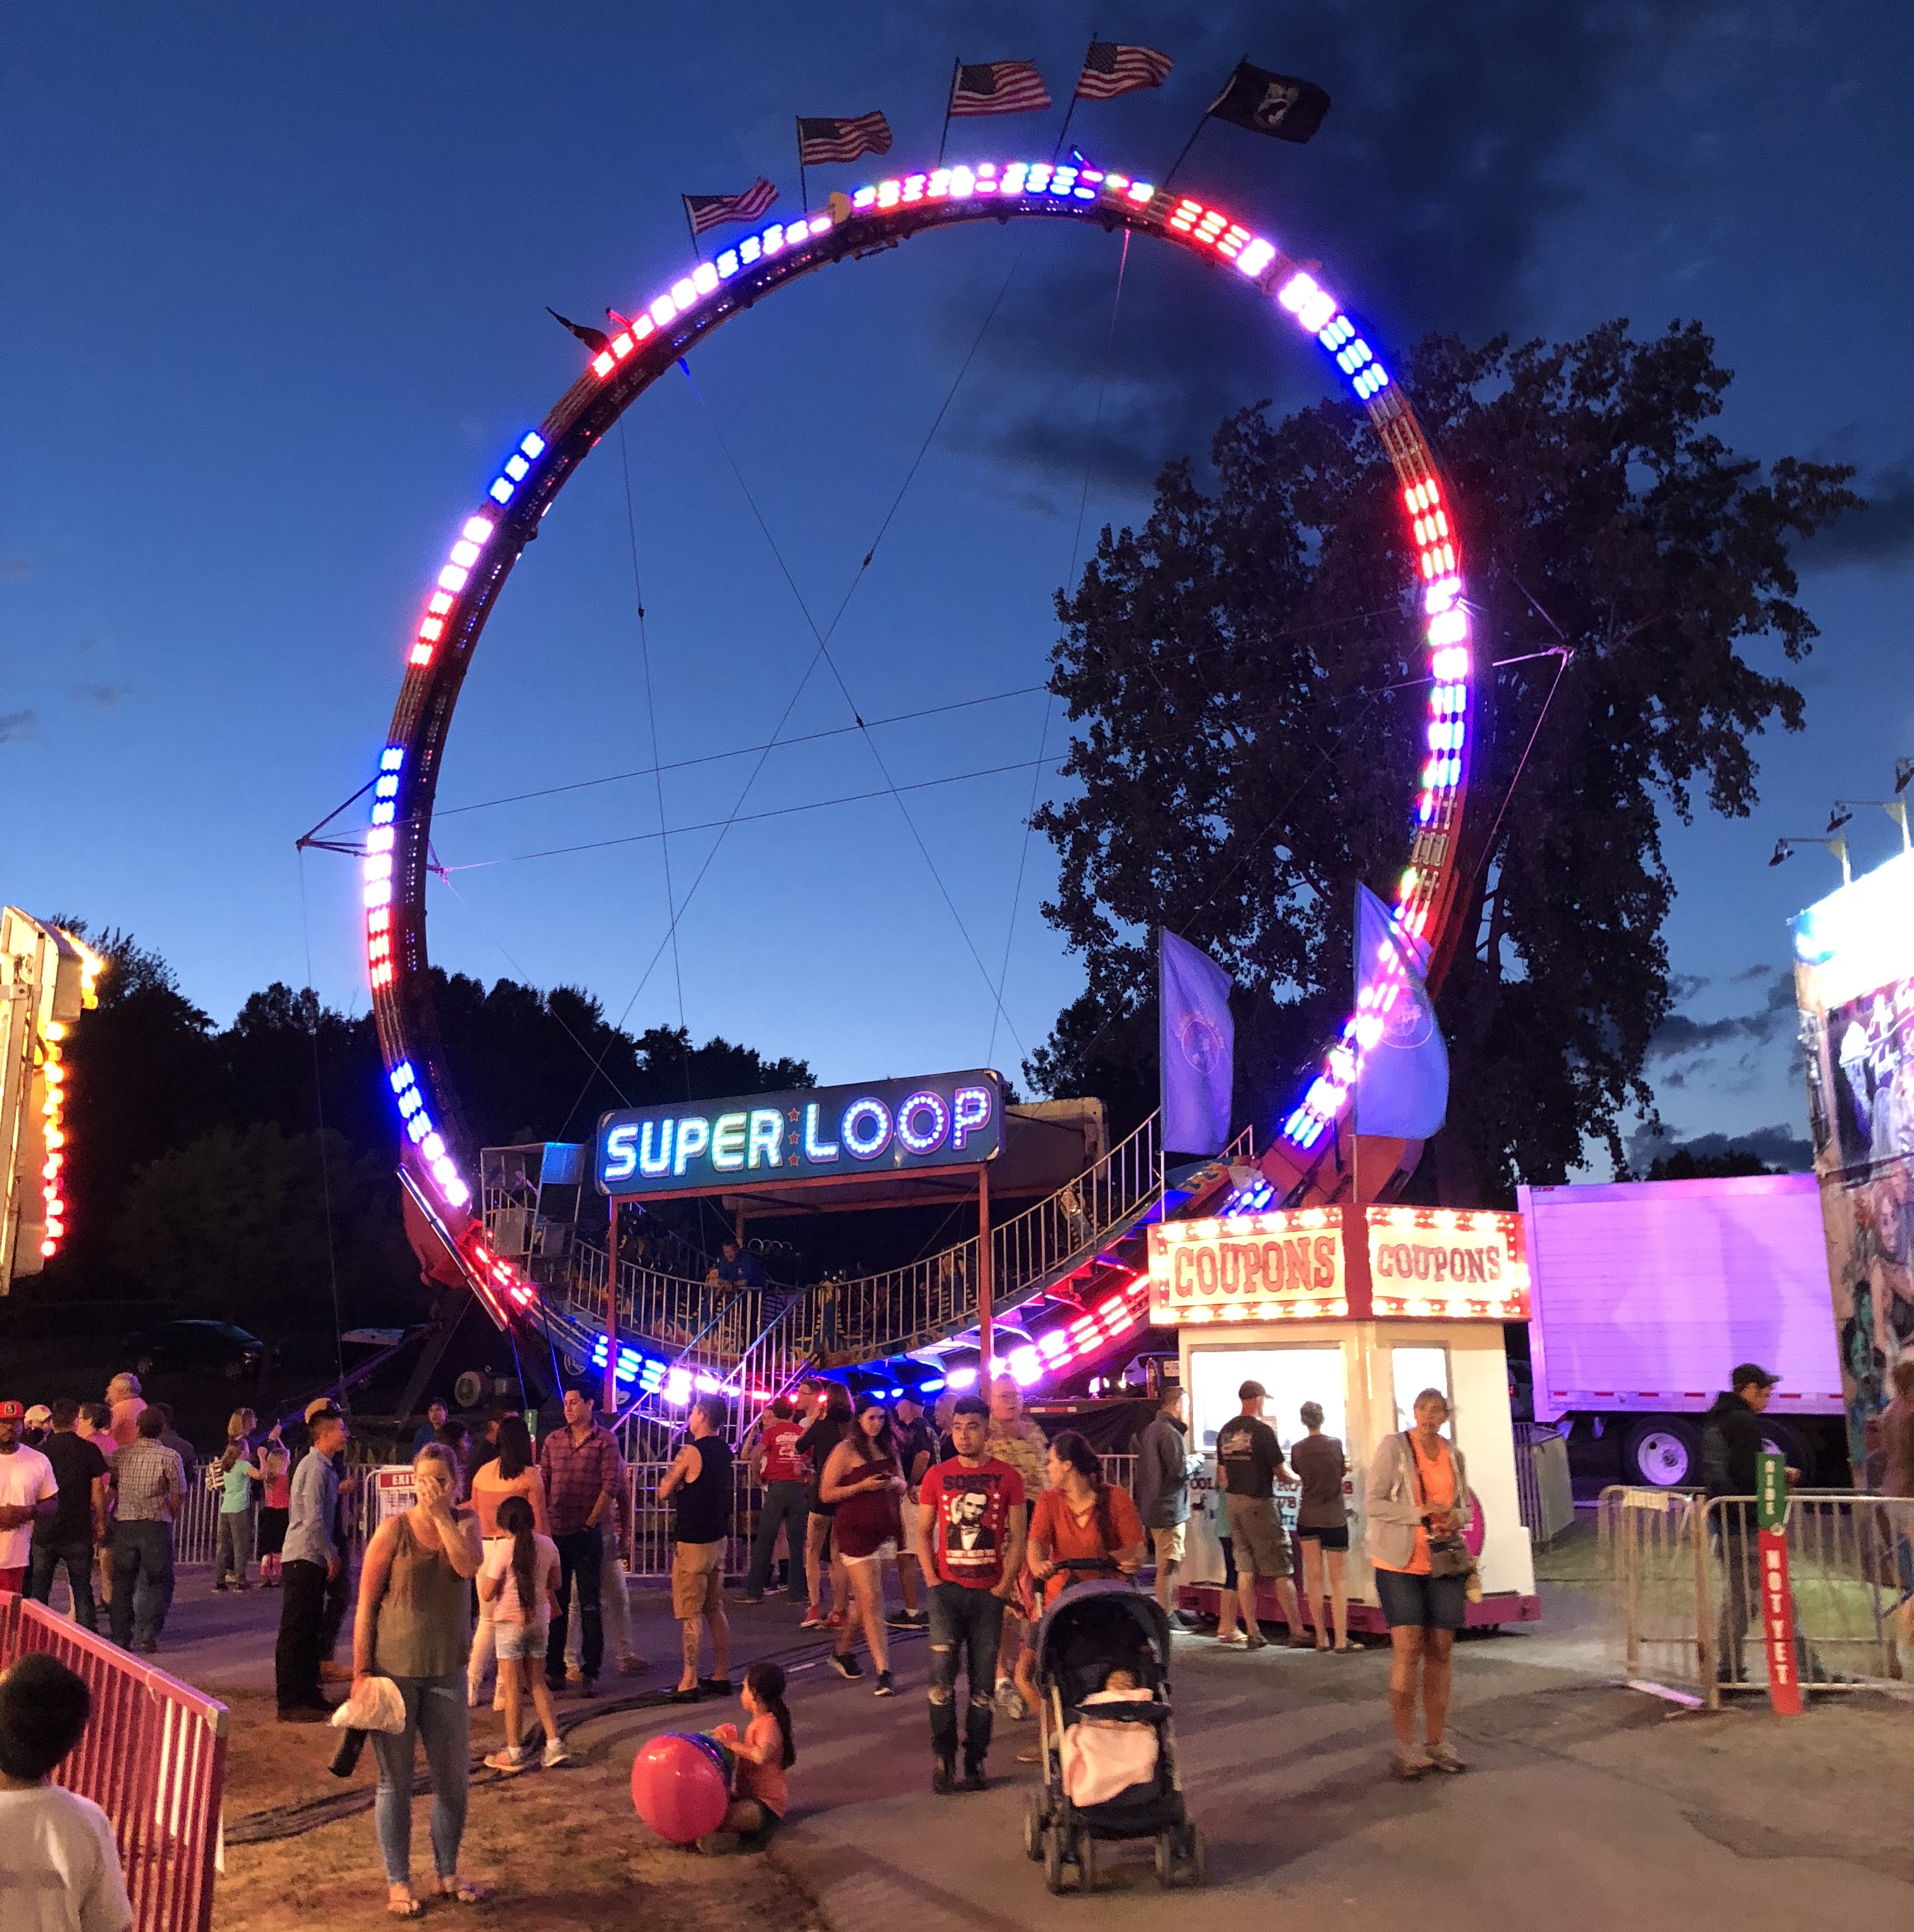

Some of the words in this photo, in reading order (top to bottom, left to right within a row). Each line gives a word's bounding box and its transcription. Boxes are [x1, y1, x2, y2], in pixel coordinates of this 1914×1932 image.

[604, 1108, 785, 1182] SUPER
[805, 1086, 991, 1163] LOOP
[1174, 1236, 1336, 1298] COUPONS
[1377, 1243, 1502, 1284] COUPONS
[392, 1474, 416, 1486] EXIT
